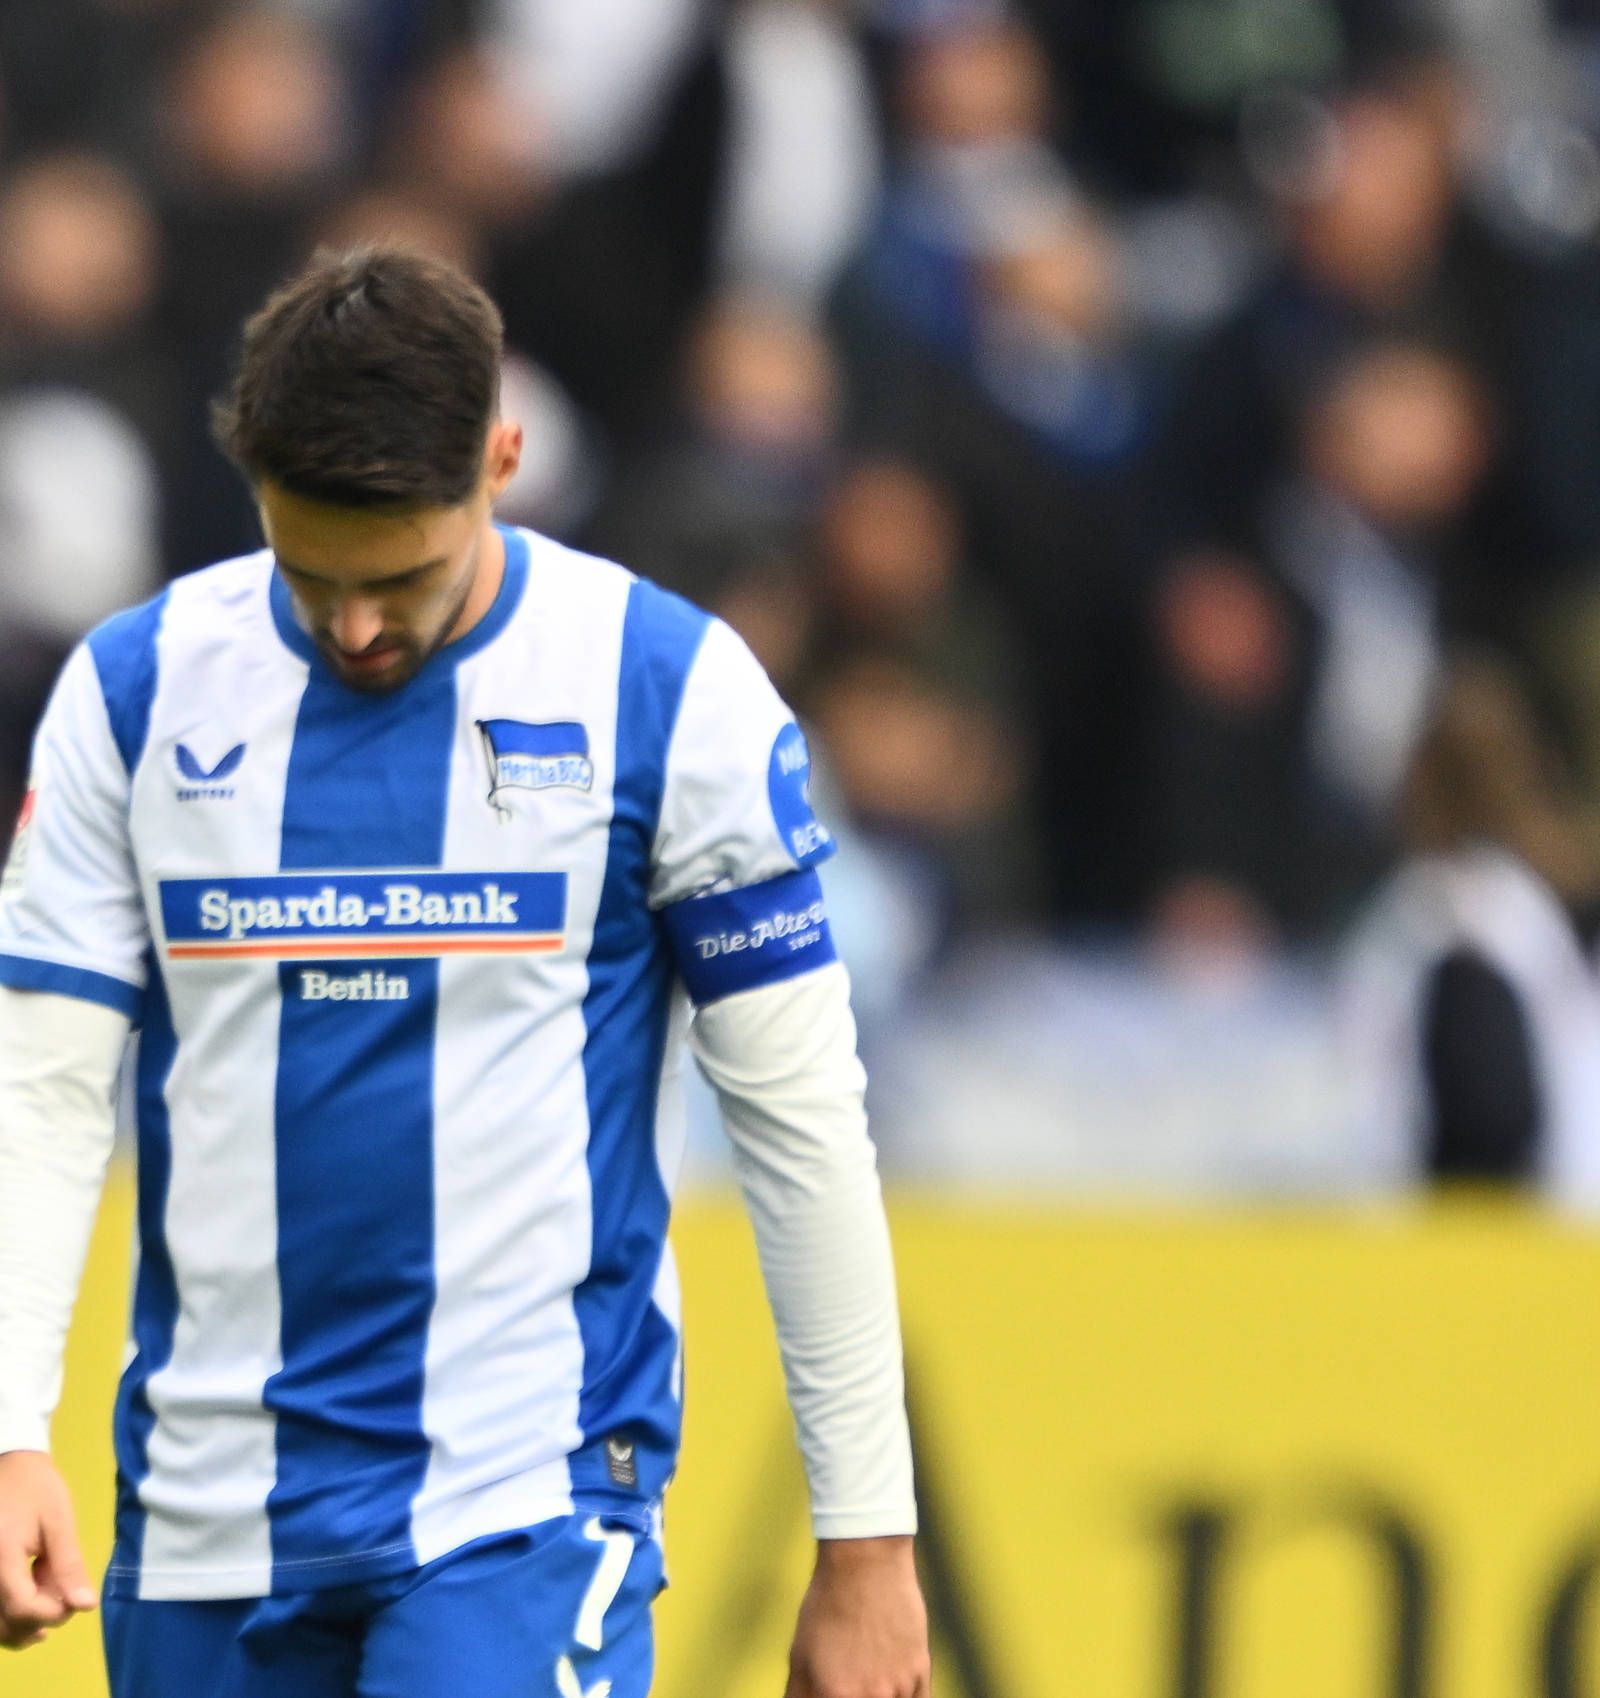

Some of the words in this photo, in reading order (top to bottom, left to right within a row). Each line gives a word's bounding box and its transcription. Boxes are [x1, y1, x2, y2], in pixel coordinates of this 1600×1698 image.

[200, 883, 518, 939] Sparda-Bank
[695, 932, 748, 959] Die
[301, 969, 409, 1001] Berlin
